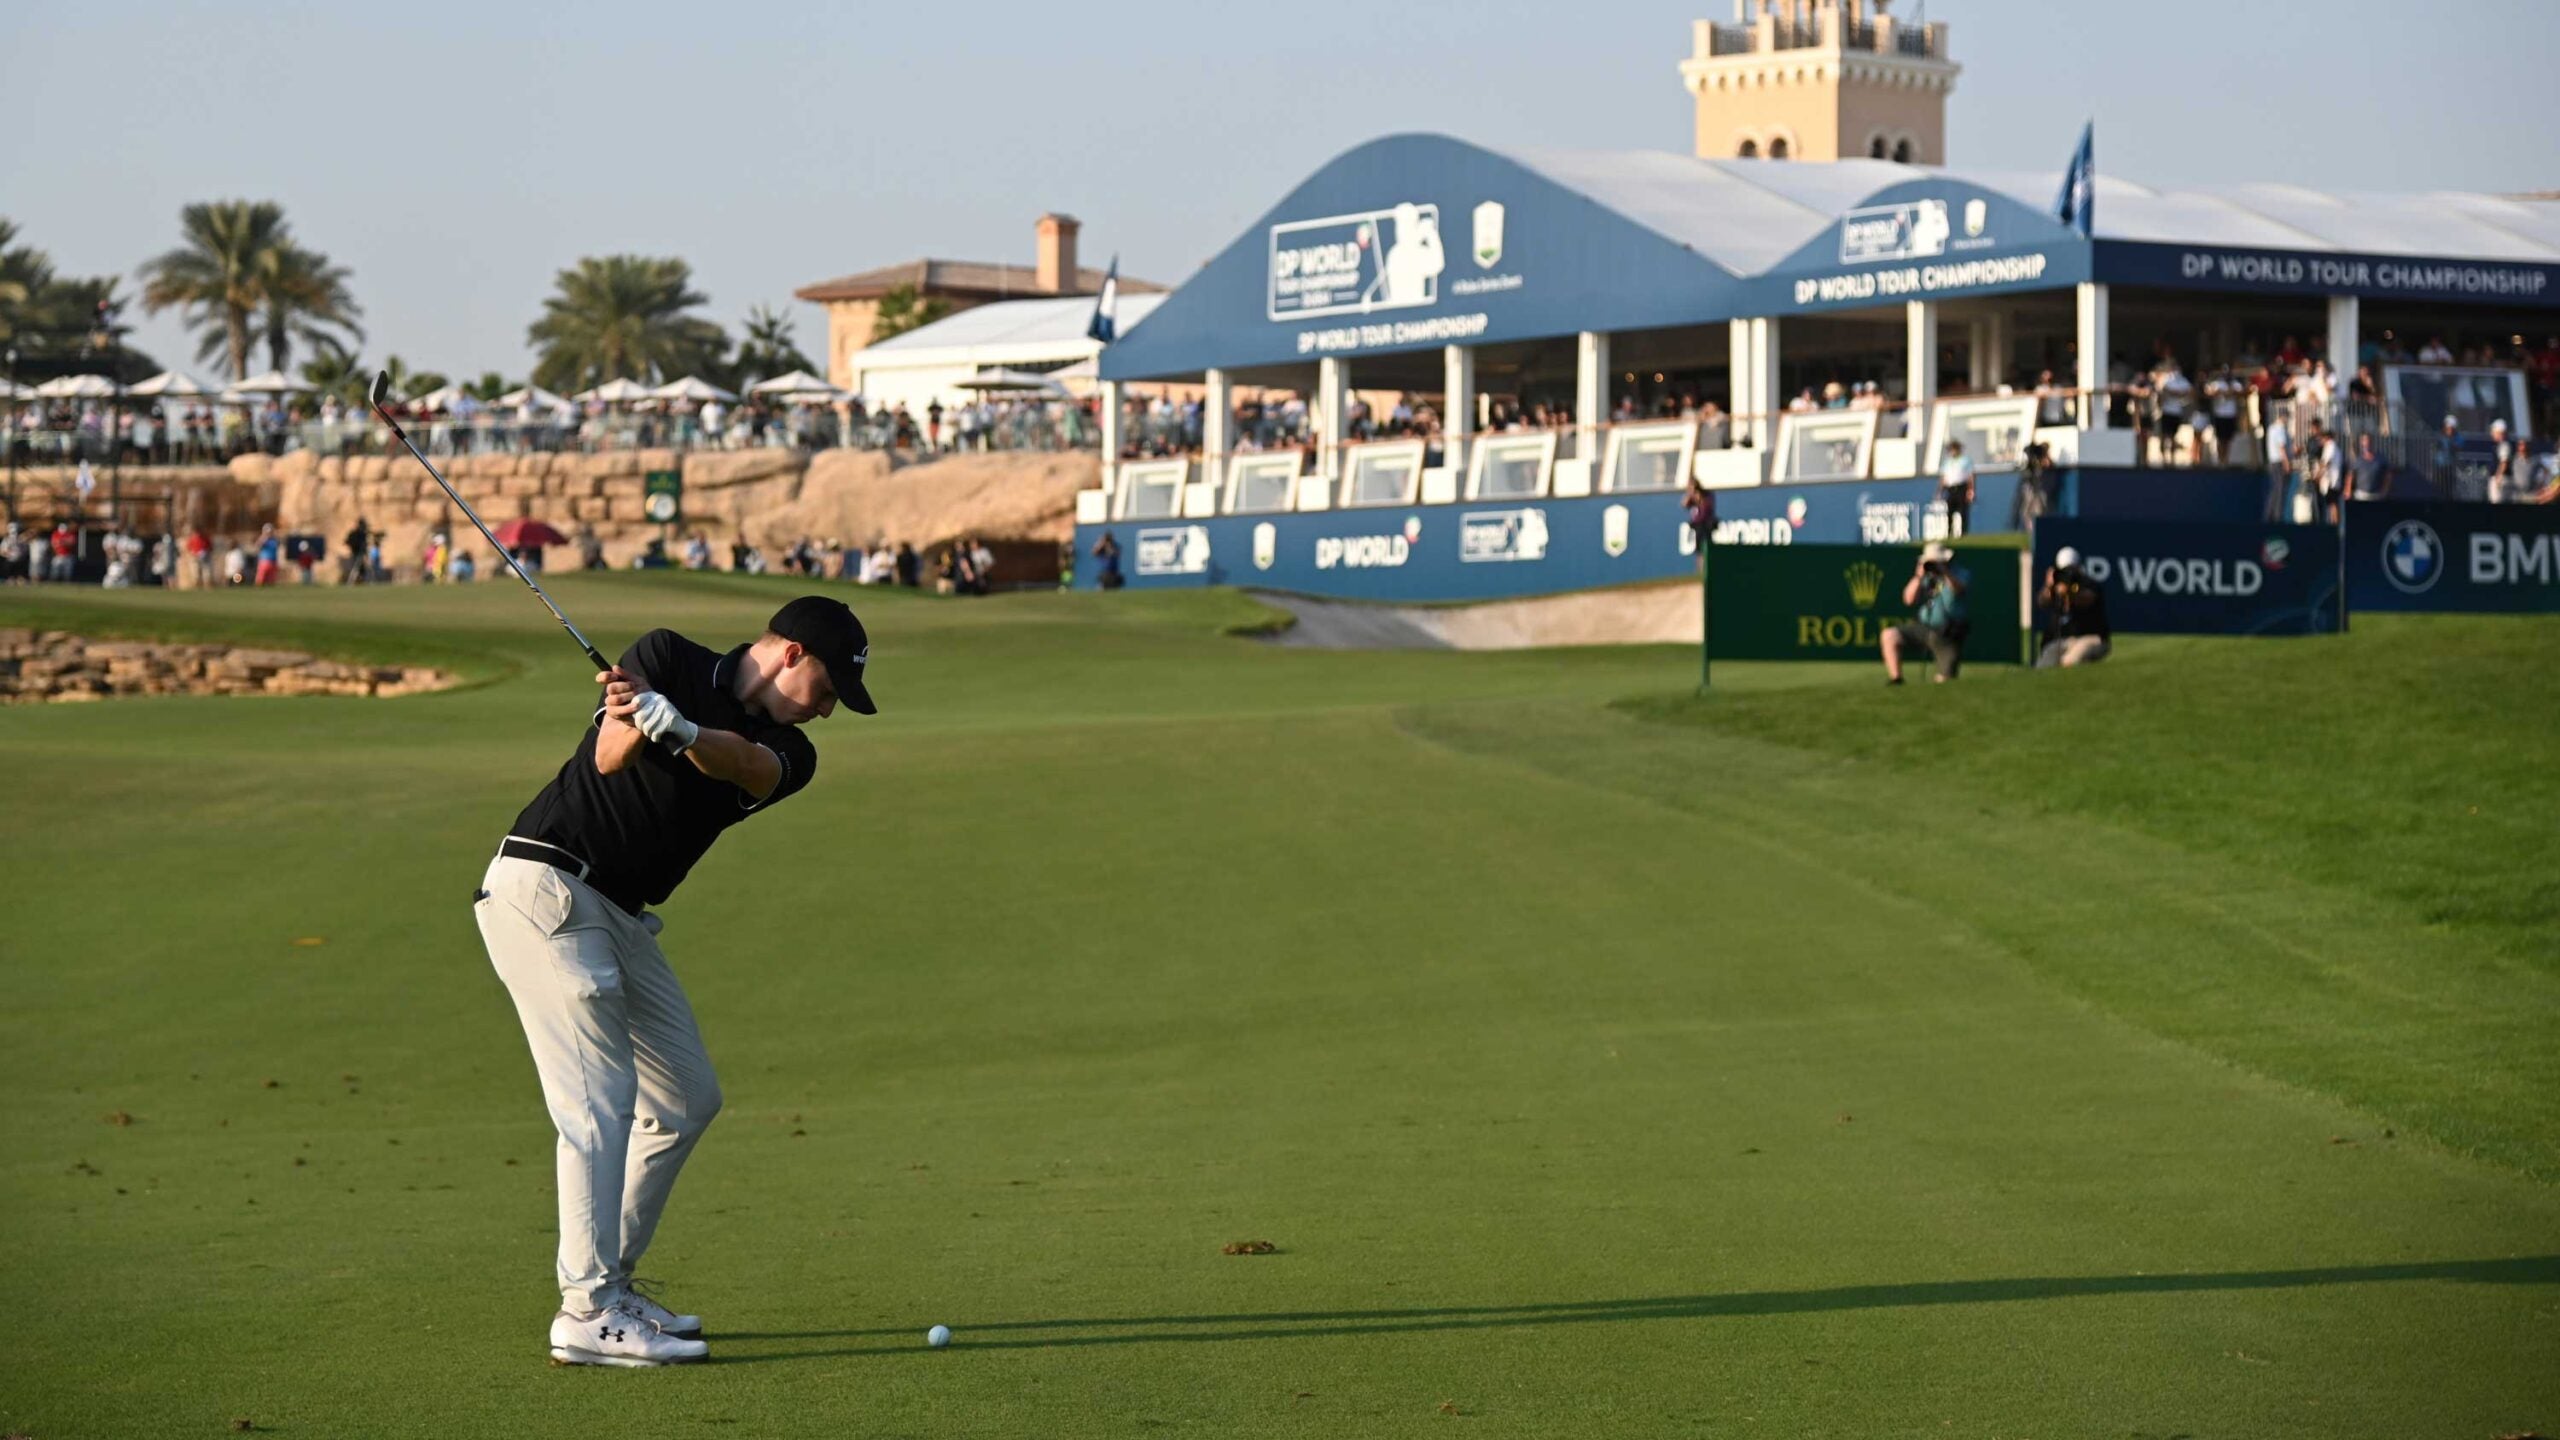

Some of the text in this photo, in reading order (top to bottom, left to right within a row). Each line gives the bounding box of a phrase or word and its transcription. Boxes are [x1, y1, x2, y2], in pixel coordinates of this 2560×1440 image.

[1277, 241, 1361, 278] DP WORLD
[1795, 253, 2046, 304] DP WORLD TOUR CHAMPIONSHIP
[2181, 252, 2547, 295] DP WORLD TOUR CHAMPIONSHIP
[1298, 312, 1488, 354] DP WORLD TOUR CHAMPIONSHIP
[1860, 514, 1911, 547] TOUR
[1316, 534, 1410, 570] DP WORLD
[2470, 532, 2560, 585] BM
[2117, 556, 2263, 595] WORLD
